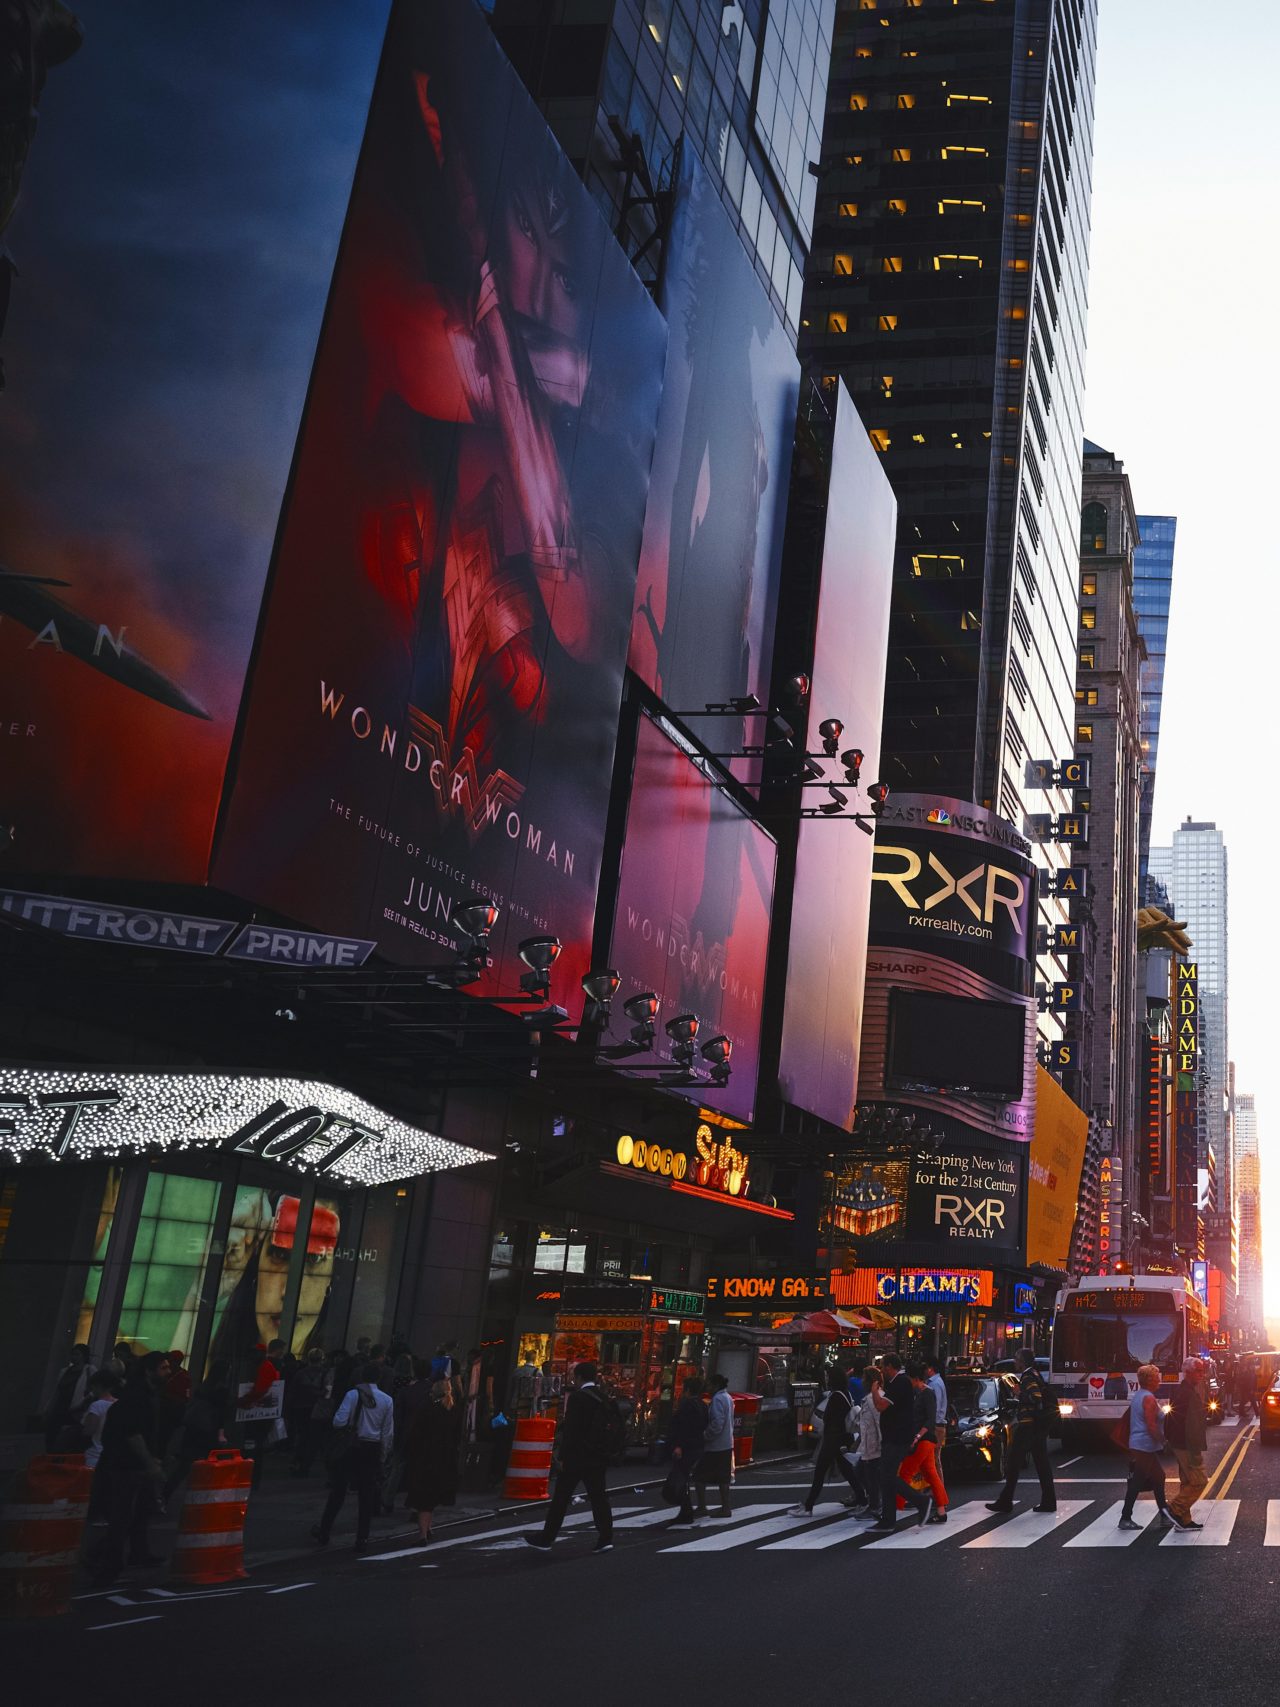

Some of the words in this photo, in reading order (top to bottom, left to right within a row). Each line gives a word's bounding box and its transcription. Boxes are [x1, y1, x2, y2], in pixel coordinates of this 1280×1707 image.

[320, 679, 469, 804] WONDER
[485, 794, 575, 877] WOMAN
[329, 798, 351, 820] THE
[358, 816, 400, 848] FUTURE
[406, 843, 421, 857] OF
[425, 854, 466, 884] JUSTICE
[470, 879, 504, 905] BEGINS
[509, 902, 529, 920] WITH
[533, 915, 549, 930] HER
[403, 877, 453, 923] JUN
[872, 845, 1024, 935] RXR
[908, 913, 993, 940] rxrrealty.com
[247, 935, 360, 966] PRIME
[627, 906, 698, 972] WONDER
[708, 958, 758, 1008] WOMAN
[867, 961, 927, 975] SHARP
[1178, 963, 1197, 1072] MADAME
[972, 1155, 996, 1170] New
[997, 1159, 1015, 1174] York
[915, 1170, 935, 1184] for
[939, 1172, 959, 1186] the
[961, 1174, 982, 1189] 21st
[984, 1177, 1017, 1196] Century
[934, 1194, 1005, 1229] RXR
[950, 1227, 995, 1239] REALTY
[723, 1278, 774, 1297] KNOW
[877, 1275, 981, 1300] CHAMPS
[558, 1320, 593, 1328] HALAL
[609, 1320, 642, 1328] FOOD
